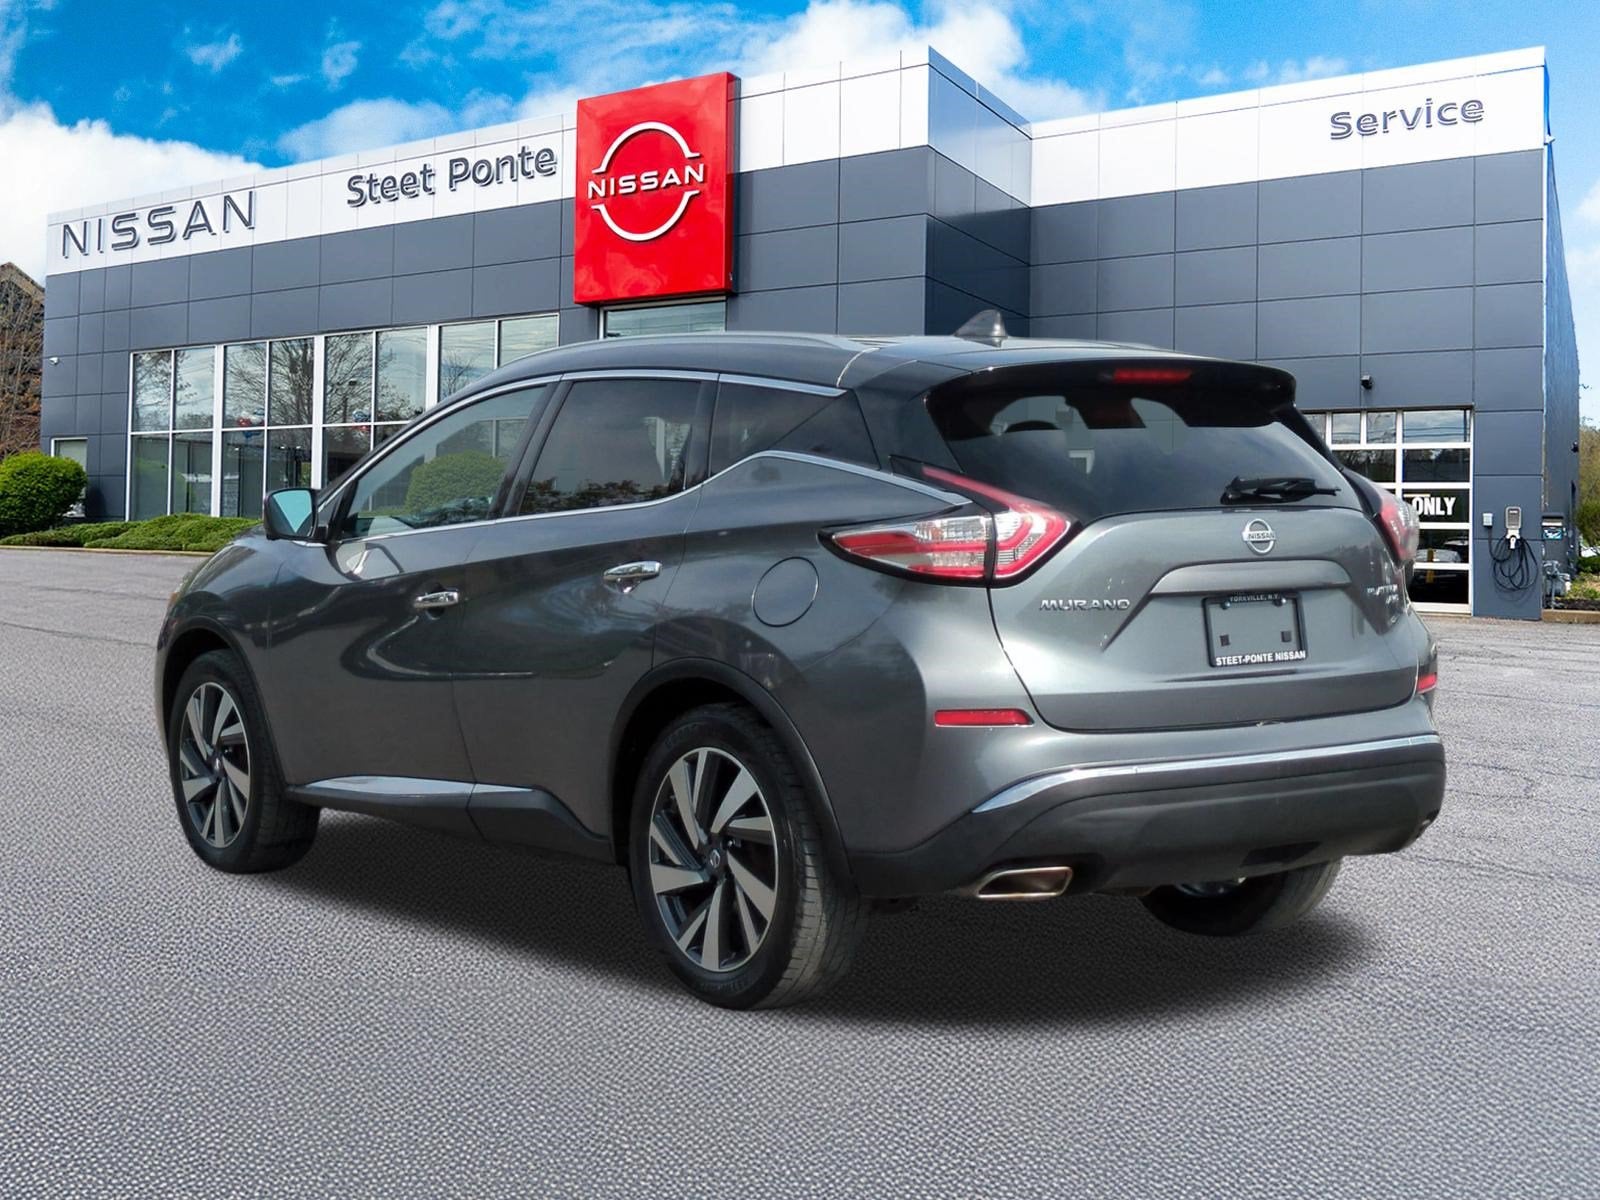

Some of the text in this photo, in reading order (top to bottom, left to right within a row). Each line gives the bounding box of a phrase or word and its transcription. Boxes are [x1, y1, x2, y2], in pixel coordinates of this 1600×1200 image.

[1330, 98, 1485, 140] Service
[347, 145, 557, 208] Steet Ponte
[587, 163, 705, 199] NISSAN
[62, 190, 256, 259] NISSAN
[1412, 497, 1456, 516] ONLY
[1040, 599, 1130, 611] MURANO
[1215, 650, 1306, 666] STEET-PONTE NISSAN
